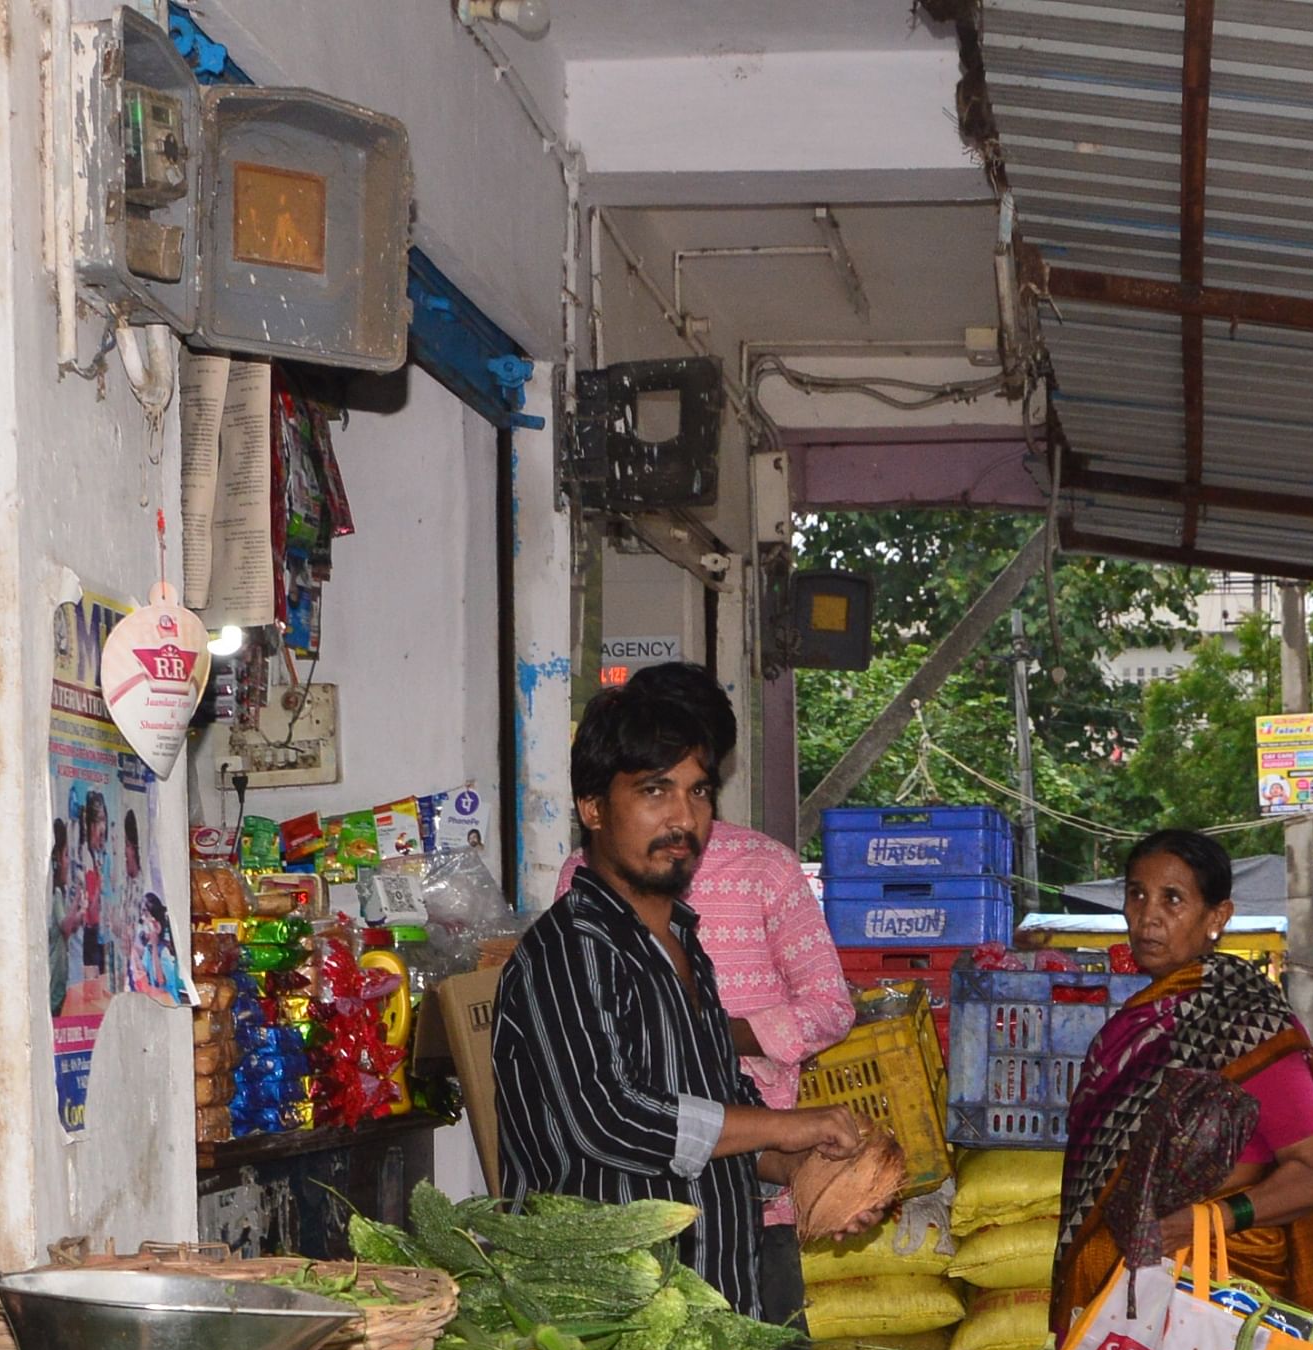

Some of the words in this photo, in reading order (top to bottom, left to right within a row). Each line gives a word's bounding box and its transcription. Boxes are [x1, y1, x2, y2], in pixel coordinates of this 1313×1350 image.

[600, 641, 676, 657] AGENCY
[153, 656, 187, 680] RR
[447, 815, 480, 827] PhonePe
[869, 909, 943, 935] HATSUN
